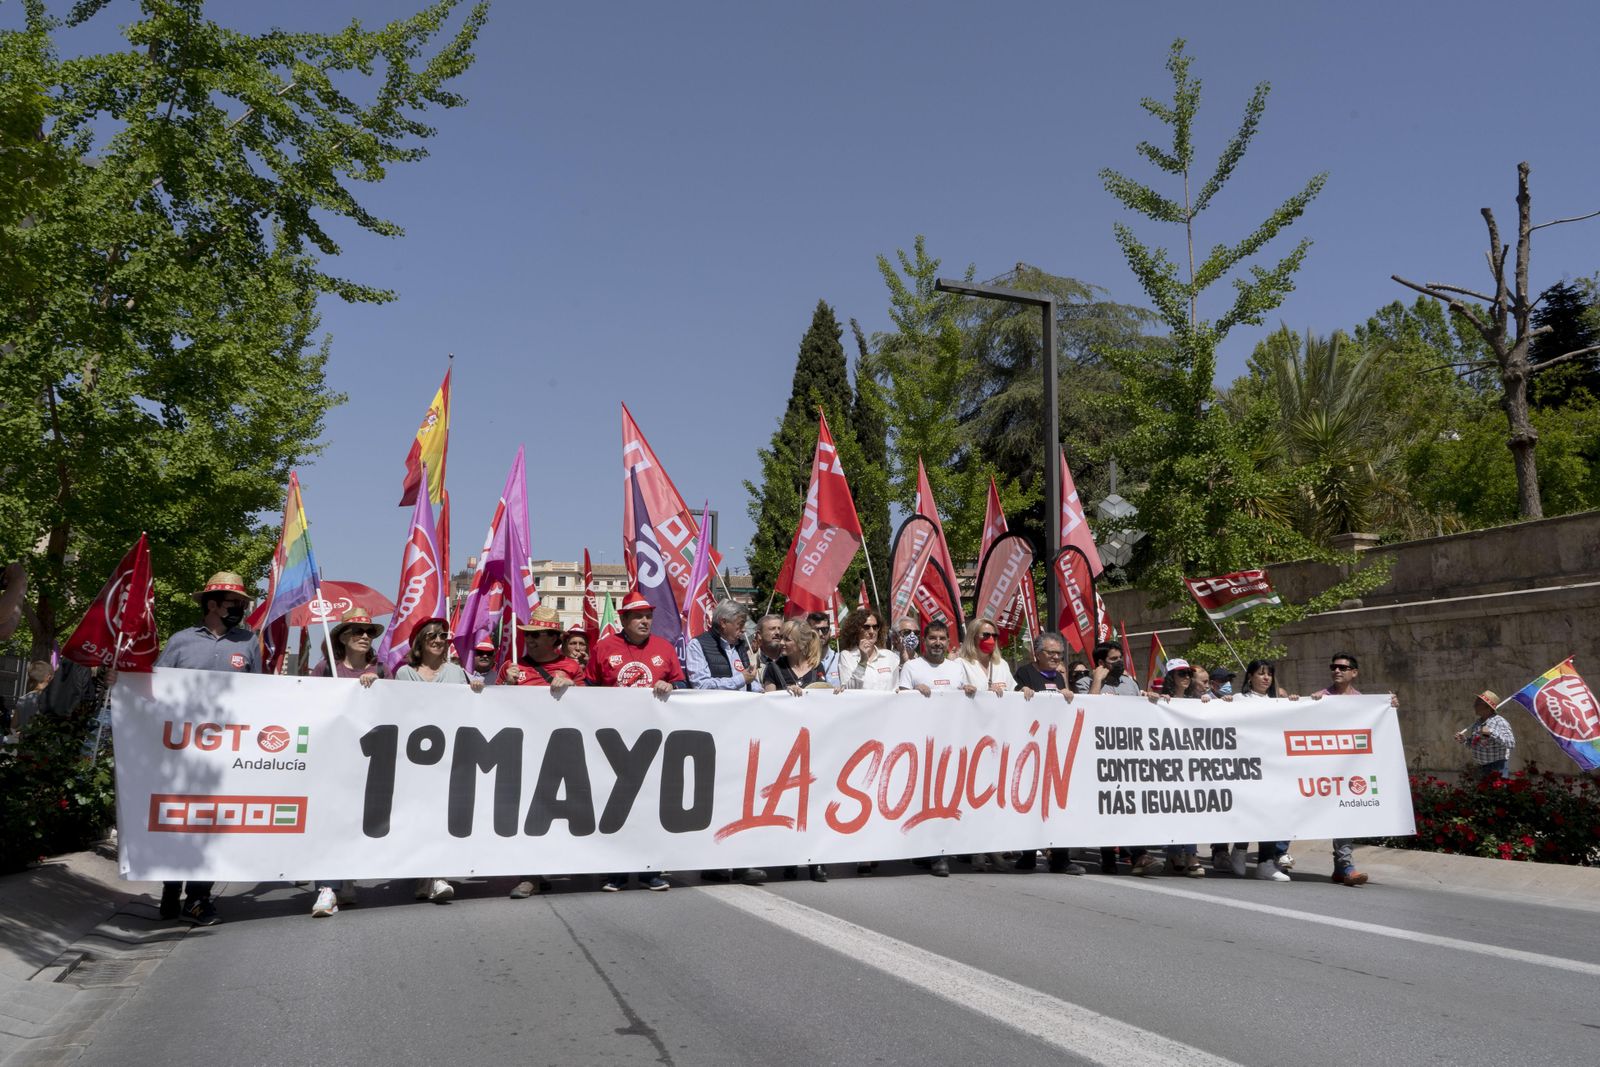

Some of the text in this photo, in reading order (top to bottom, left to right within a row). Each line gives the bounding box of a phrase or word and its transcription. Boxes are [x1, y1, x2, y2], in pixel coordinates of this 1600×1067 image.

[162, 720, 251, 752] UGT
[1095, 726, 1237, 751] SUBIR SALARIOS
[1289, 733, 1355, 752] CCOO
[232, 758, 307, 771] Andalucía
[713, 726, 817, 844] LA
[825, 708, 1085, 836] SOLUCIÓN
[1097, 757, 1262, 782] CONTENER PRECIOS
[1298, 776, 1344, 797] UGT
[1098, 784, 1233, 815] MÁS IGUALDAD
[1339, 798, 1380, 808] Andalucía
[158, 802, 272, 827] CCOO
